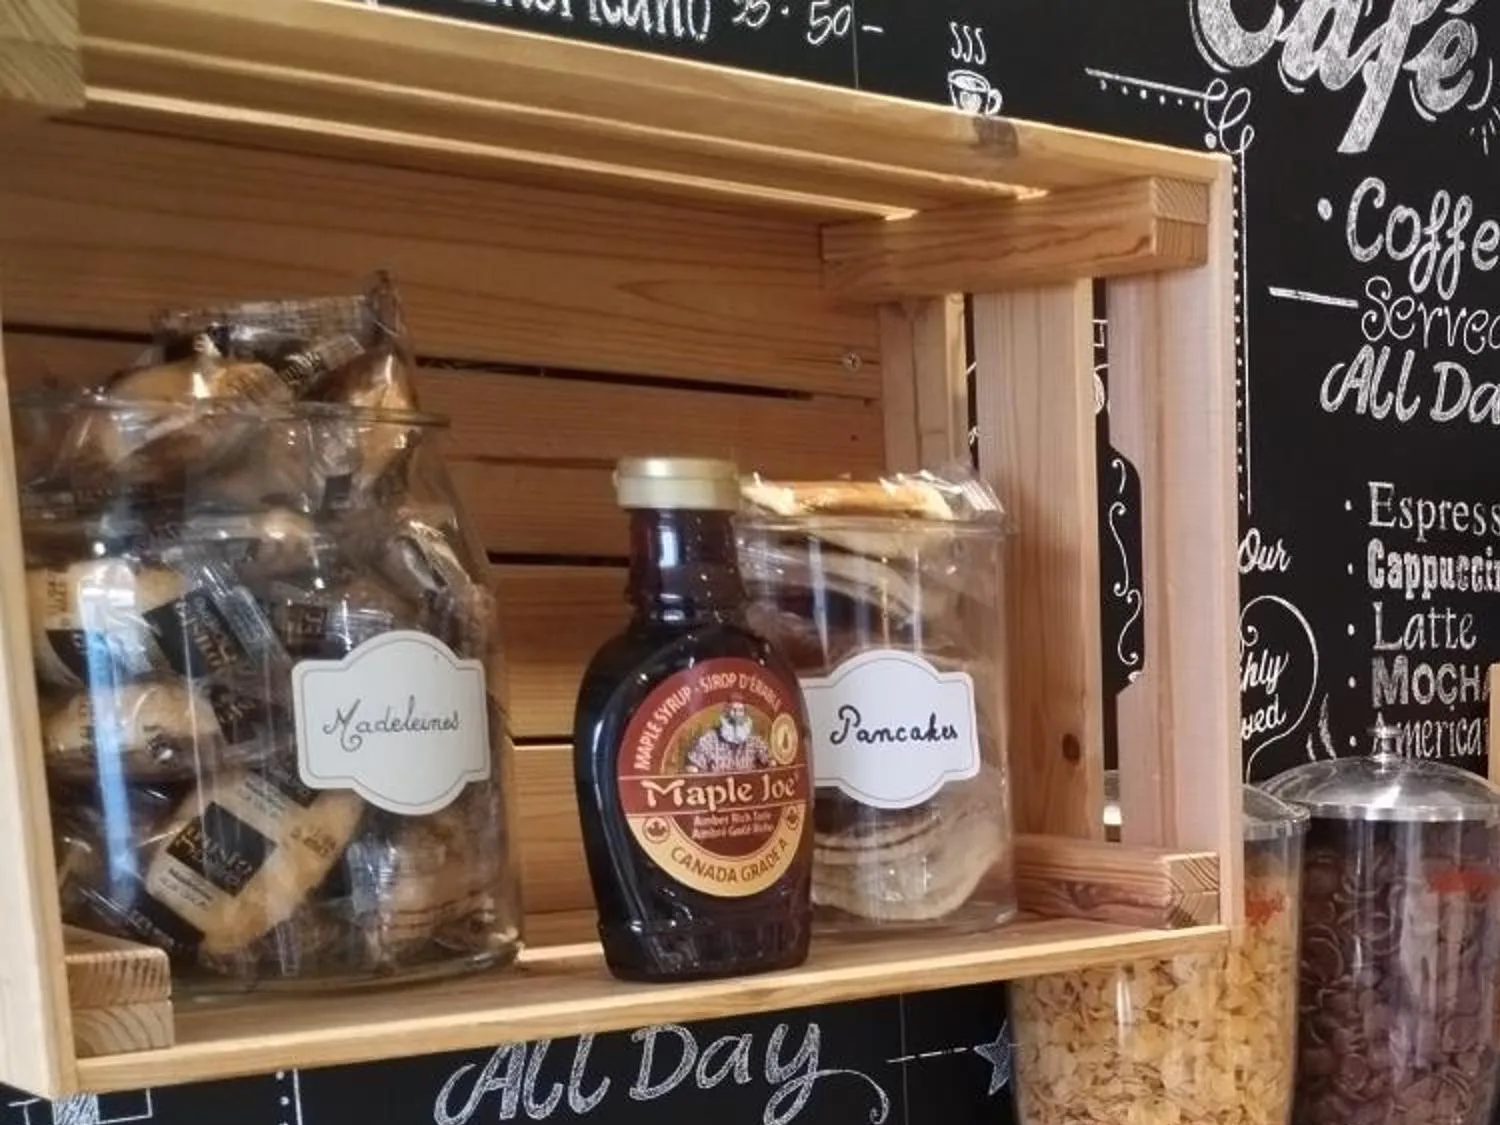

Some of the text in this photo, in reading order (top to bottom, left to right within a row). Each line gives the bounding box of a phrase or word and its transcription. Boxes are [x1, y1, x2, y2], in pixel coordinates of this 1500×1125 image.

[1320, 344, 1421, 422] All
[1239, 528, 1290, 575] Our
[1371, 601, 1477, 651] Latte
[1372, 655, 1490, 707] MOCH
[323, 696, 461, 752] Madeleines
[634, 721, 663, 771] MAPLE
[653, 685, 691, 725] SYRUP
[830, 704, 958, 746] Pancakes
[641, 774, 753, 811] Maple
[671, 846, 738, 883] CANADA
[740, 849, 780, 881] GRADE
